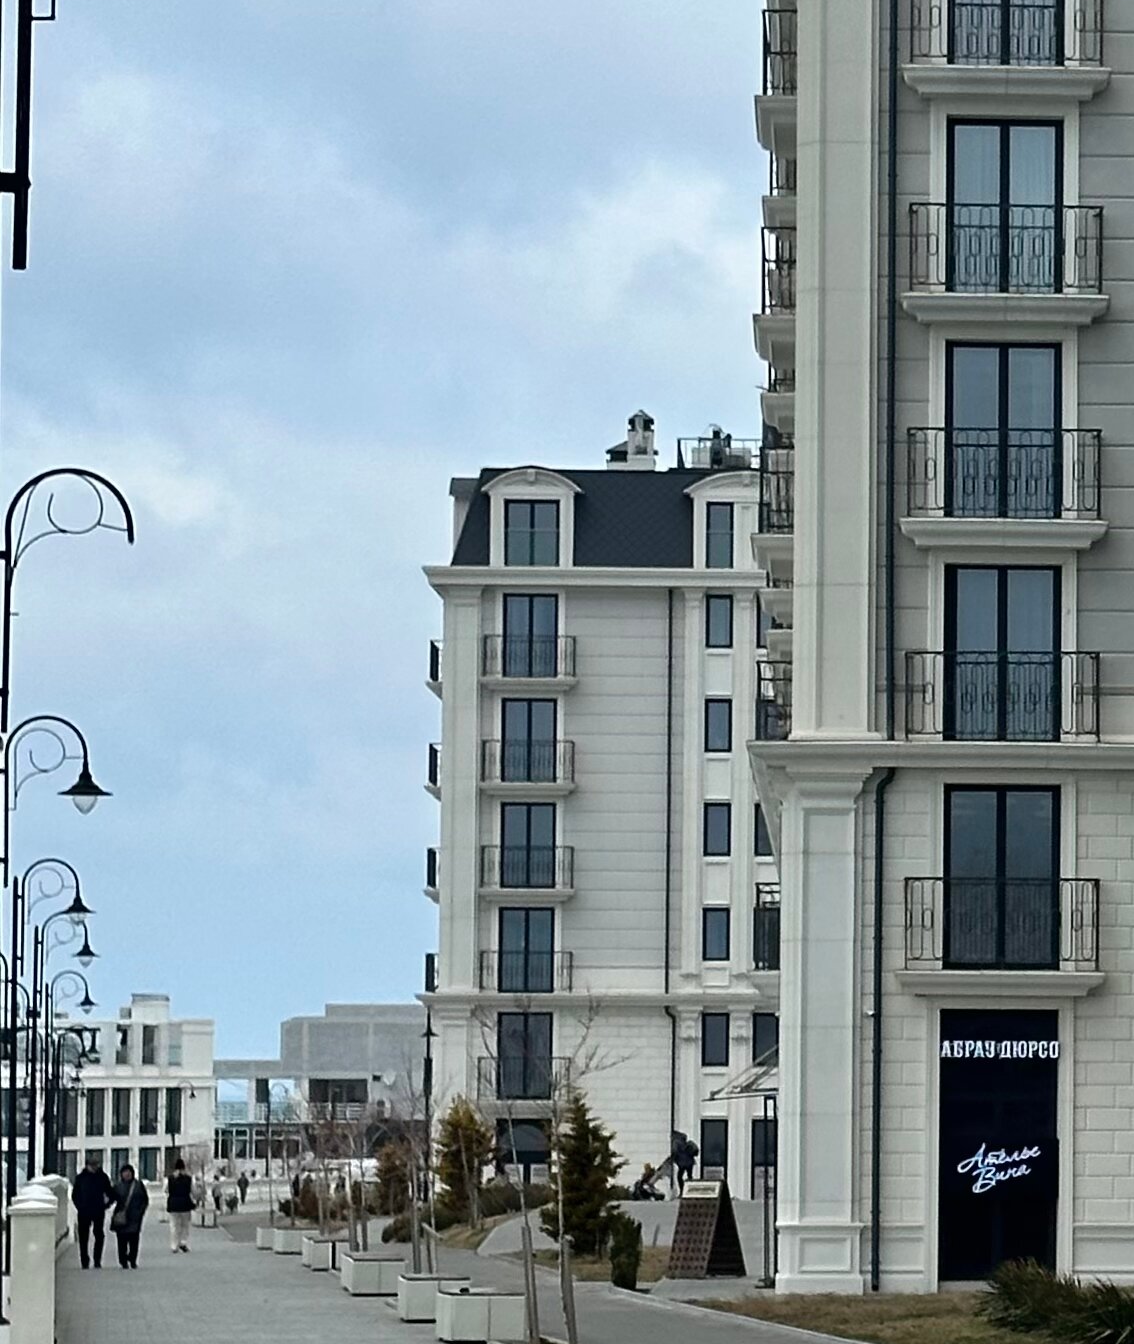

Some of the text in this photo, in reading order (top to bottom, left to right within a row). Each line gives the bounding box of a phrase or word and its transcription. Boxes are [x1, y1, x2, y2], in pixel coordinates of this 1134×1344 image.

[941, 1040, 1059, 1059] АБРАУ ДЮРСО
[957, 1142, 1041, 1173] Ателье
[972, 1164, 1032, 1193] Вина
